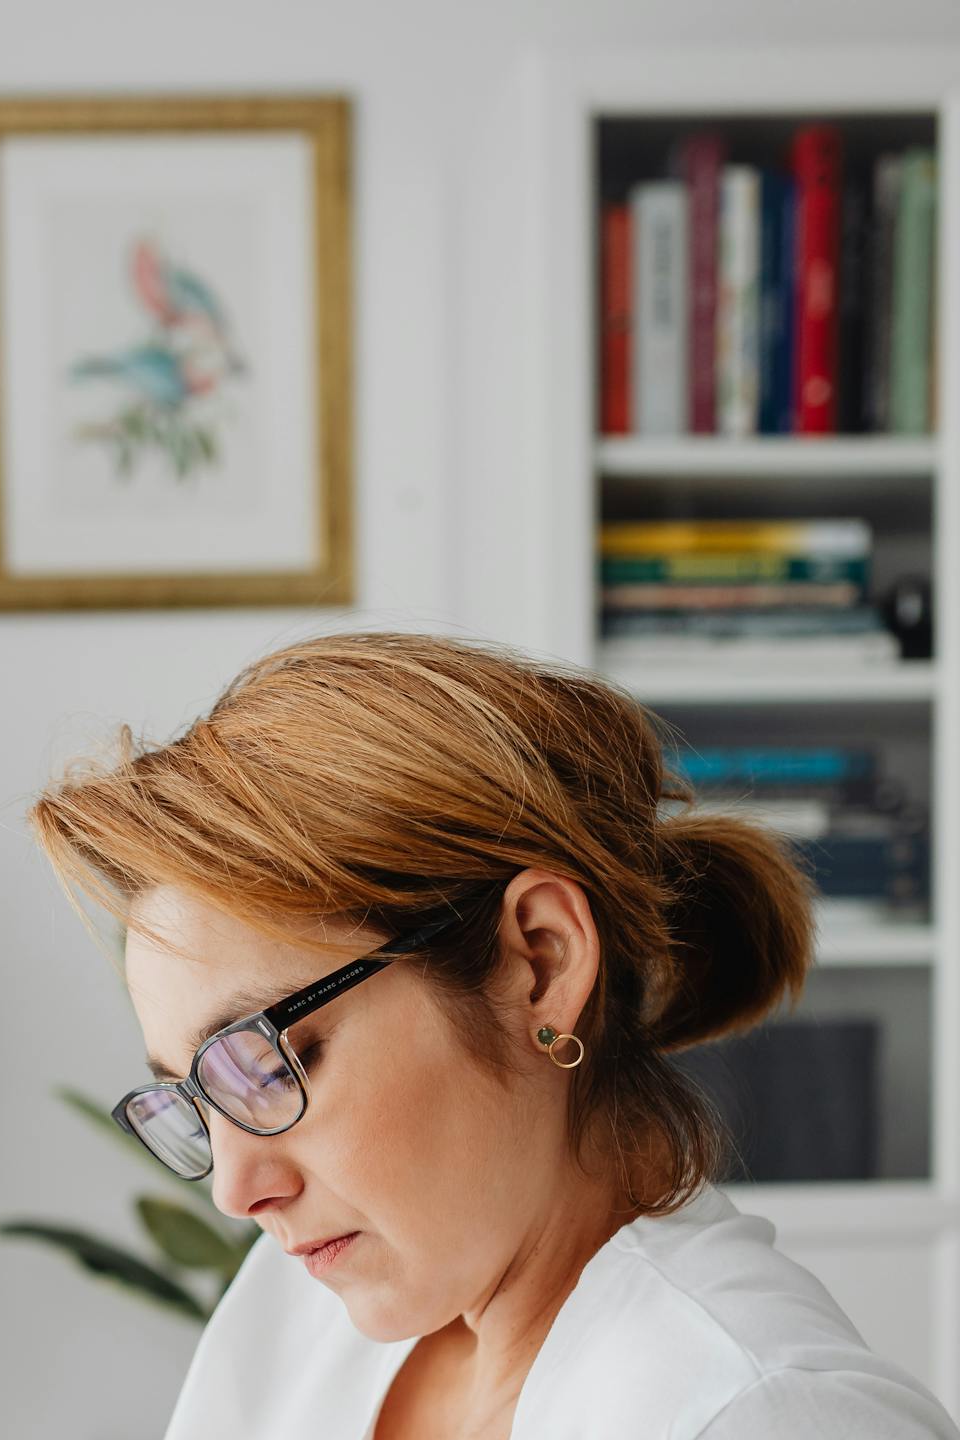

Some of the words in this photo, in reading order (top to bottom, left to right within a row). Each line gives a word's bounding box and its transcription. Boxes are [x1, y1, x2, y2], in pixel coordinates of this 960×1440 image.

[288, 1000, 307, 1013] MARC
[307, 993, 317, 1002] BY
[318, 982, 337, 995] MARC
[338, 966, 364, 984] JACOBS
